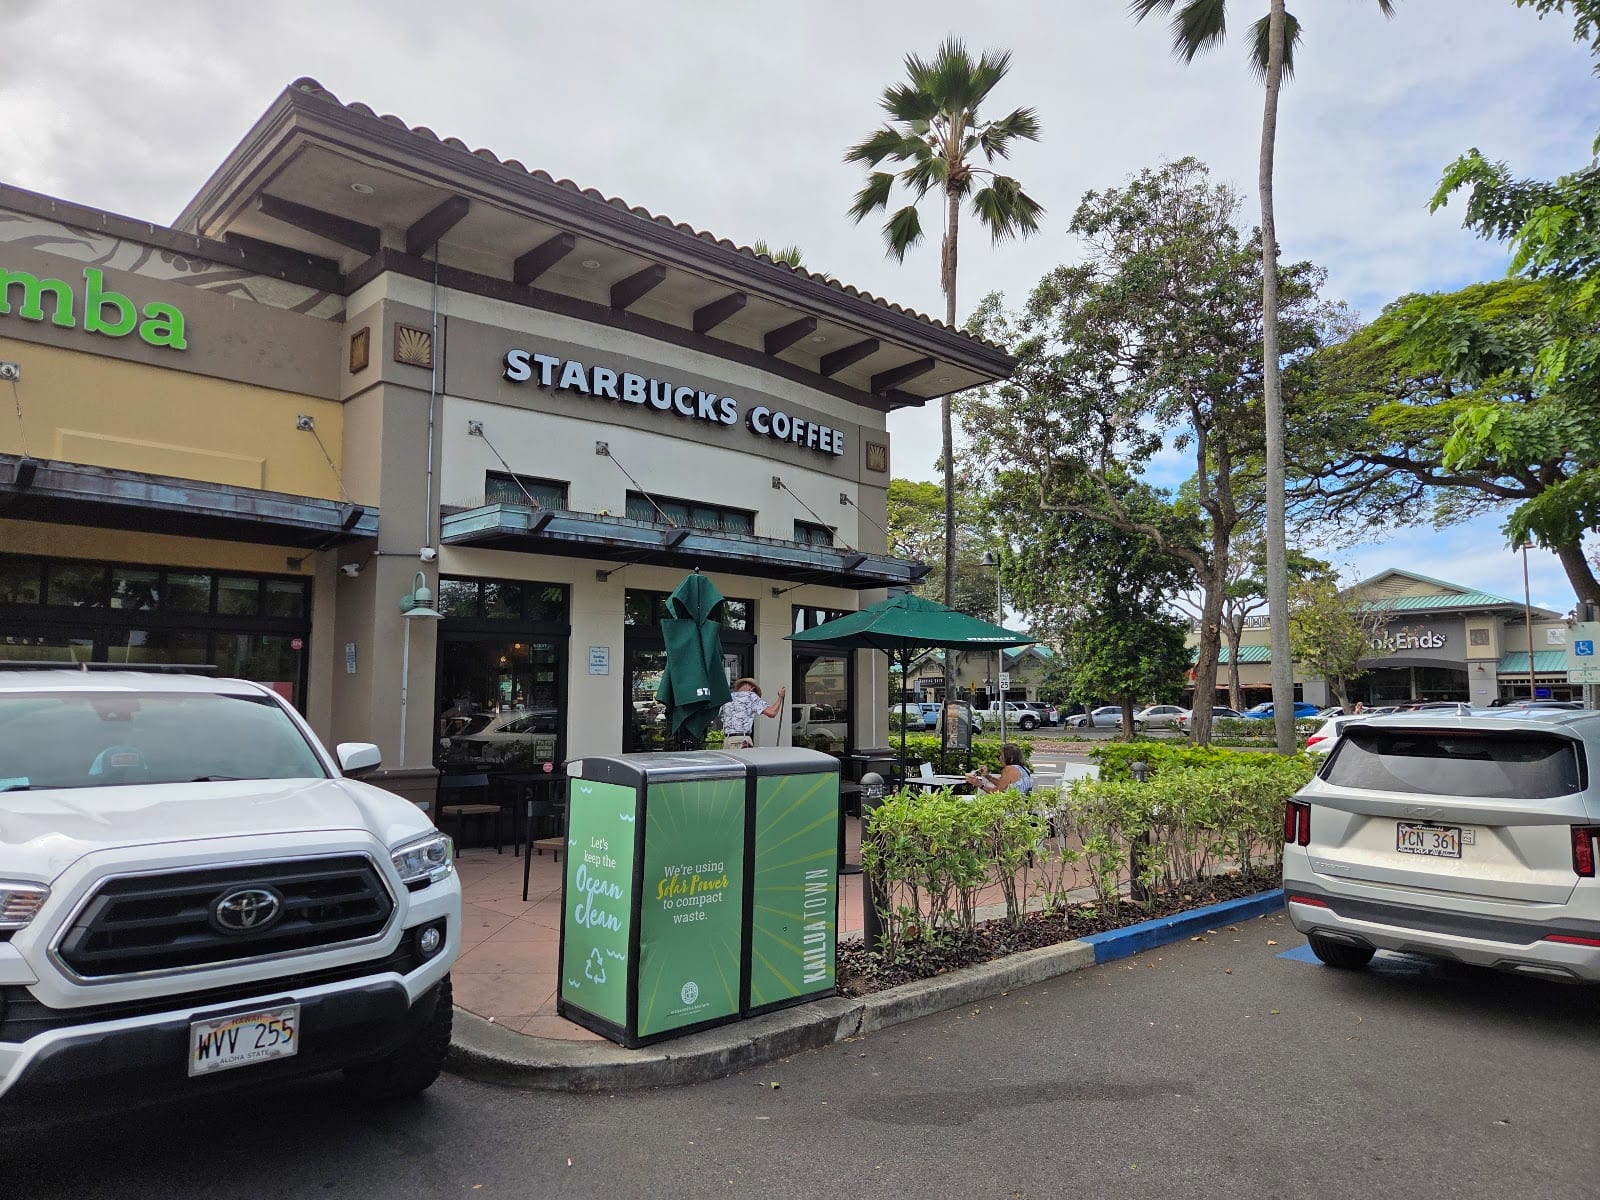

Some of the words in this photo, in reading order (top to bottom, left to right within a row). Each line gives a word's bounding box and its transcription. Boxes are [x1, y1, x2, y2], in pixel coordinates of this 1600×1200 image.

[502, 349, 738, 426] STARBUCKS
[746, 405, 845, 456] COFFEE
[1367, 631, 1444, 652] okEnds
[697, 687, 710, 696] ST
[591, 836, 608, 850] Let's
[1401, 831, 1424, 847] YCN
[1433, 834, 1455, 850] 361
[584, 850, 601, 867] keep
[602, 855, 616, 868] the
[664, 864, 693, 878] We're
[695, 861, 724, 873] using
[576, 864, 623, 900] Ocean
[656, 874, 688, 900] Solar
[690, 874, 729, 896] Power
[663, 899, 673, 909] to
[676, 892, 723, 907] compact
[575, 893, 622, 932] clean
[673, 911, 708, 924] waste.
[232, 1014, 262, 1025] HAWAII
[199, 1027, 240, 1061] WVV
[254, 1018, 294, 1049] 255
[220, 1055, 245, 1064] ALOHA
[247, 1050, 269, 1059] STATE
